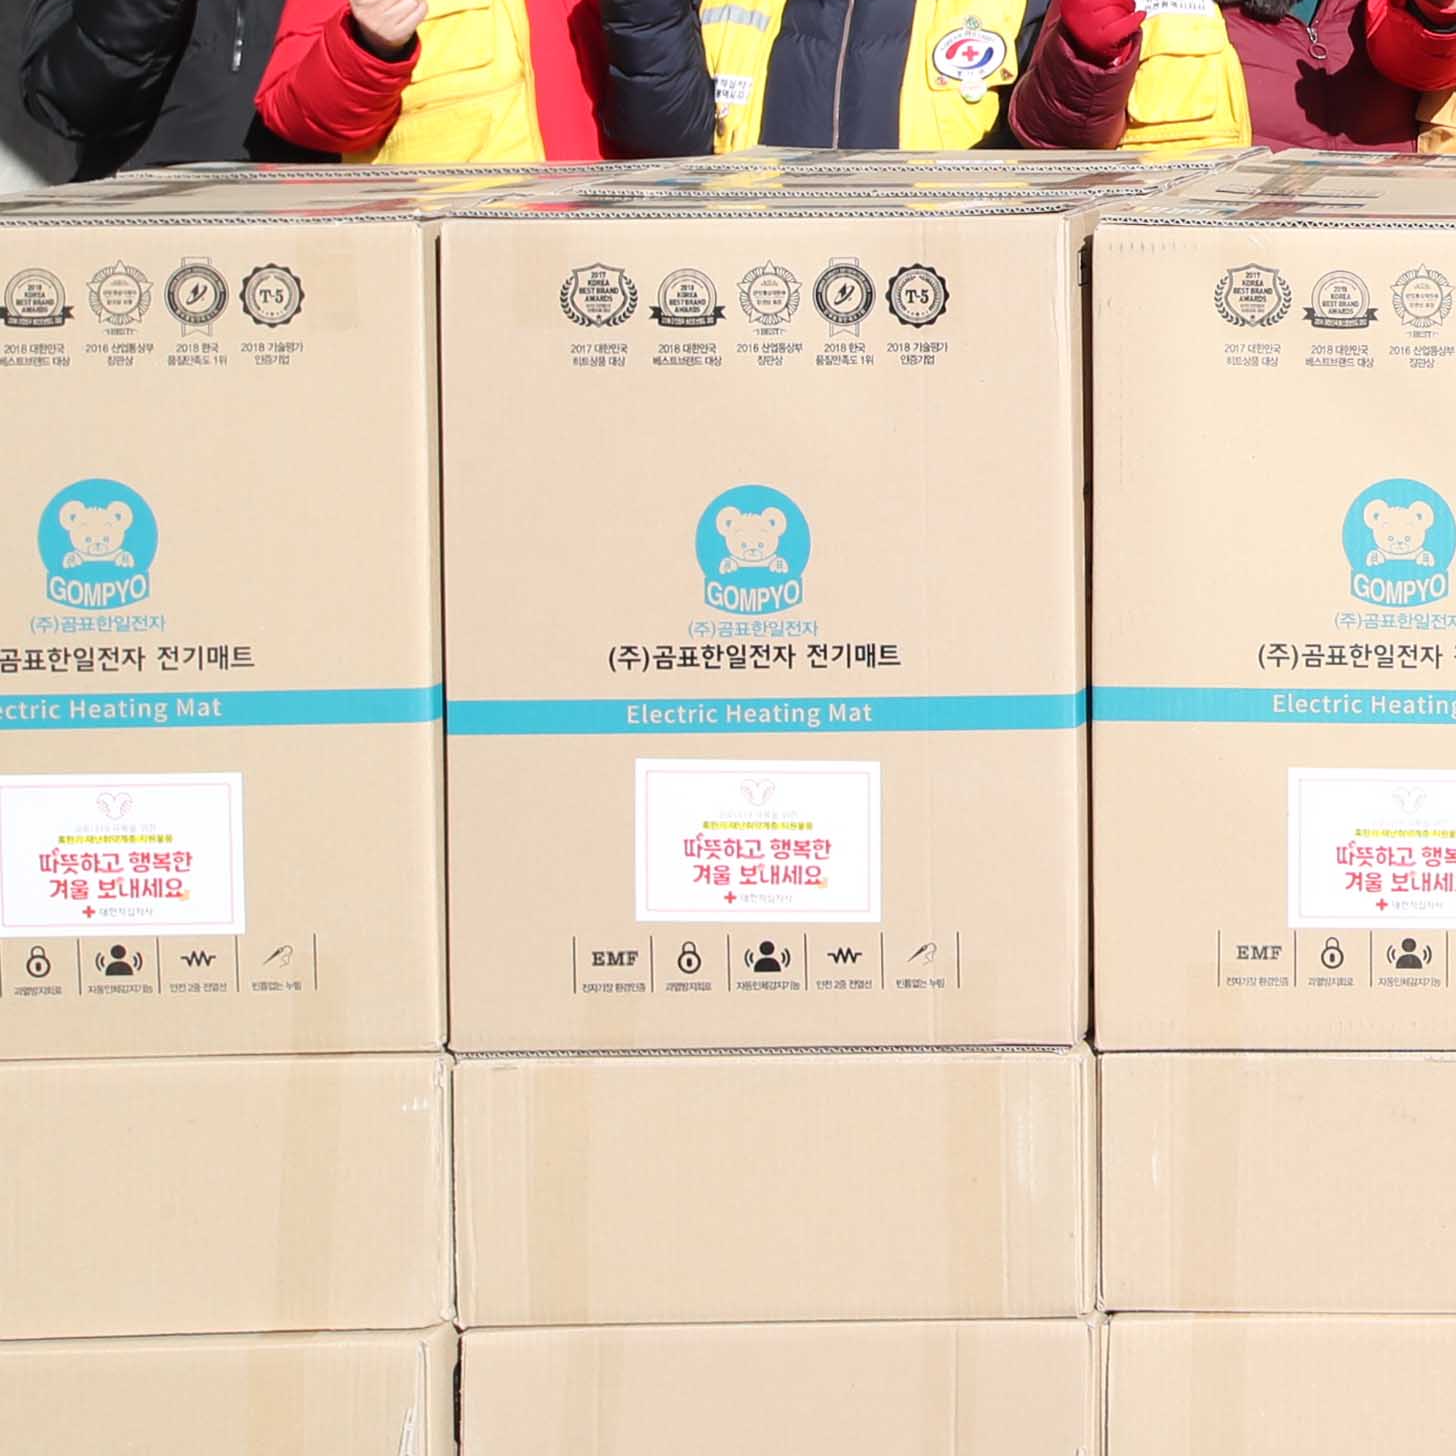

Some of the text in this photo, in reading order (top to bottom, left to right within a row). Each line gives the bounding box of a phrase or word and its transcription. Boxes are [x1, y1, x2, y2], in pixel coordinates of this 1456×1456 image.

[259, 289, 284, 304] T-5
[905, 289, 929, 304] T-5
[49, 573, 147, 608] GOMPYO
[706, 579, 800, 613] GOMPYO
[1353, 571, 1446, 606] GOMPYO
[156, 644, 255, 673] 전기매트
[608, 643, 901, 672] (주)곰표한일전자 전기매트
[1257, 640, 1444, 673] (주)곰표한일전자
[69, 698, 169, 722] Heating
[176, 698, 222, 718] Mat
[626, 703, 873, 726] Electric Heating Mat
[1272, 692, 1363, 715] Electric
[683, 832, 832, 860] 따뜻하고 행복한
[1336, 840, 1417, 868] 따뜻하고
[38, 846, 193, 875] 따뜻하고 행복한
[693, 863, 823, 886] 겨울 보내세요
[1345, 871, 1383, 893] 겨울
[49, 876, 185, 901] 겨울 보내세요
[591, 950, 639, 967] EMF
[1236, 944, 1283, 961] EMF
